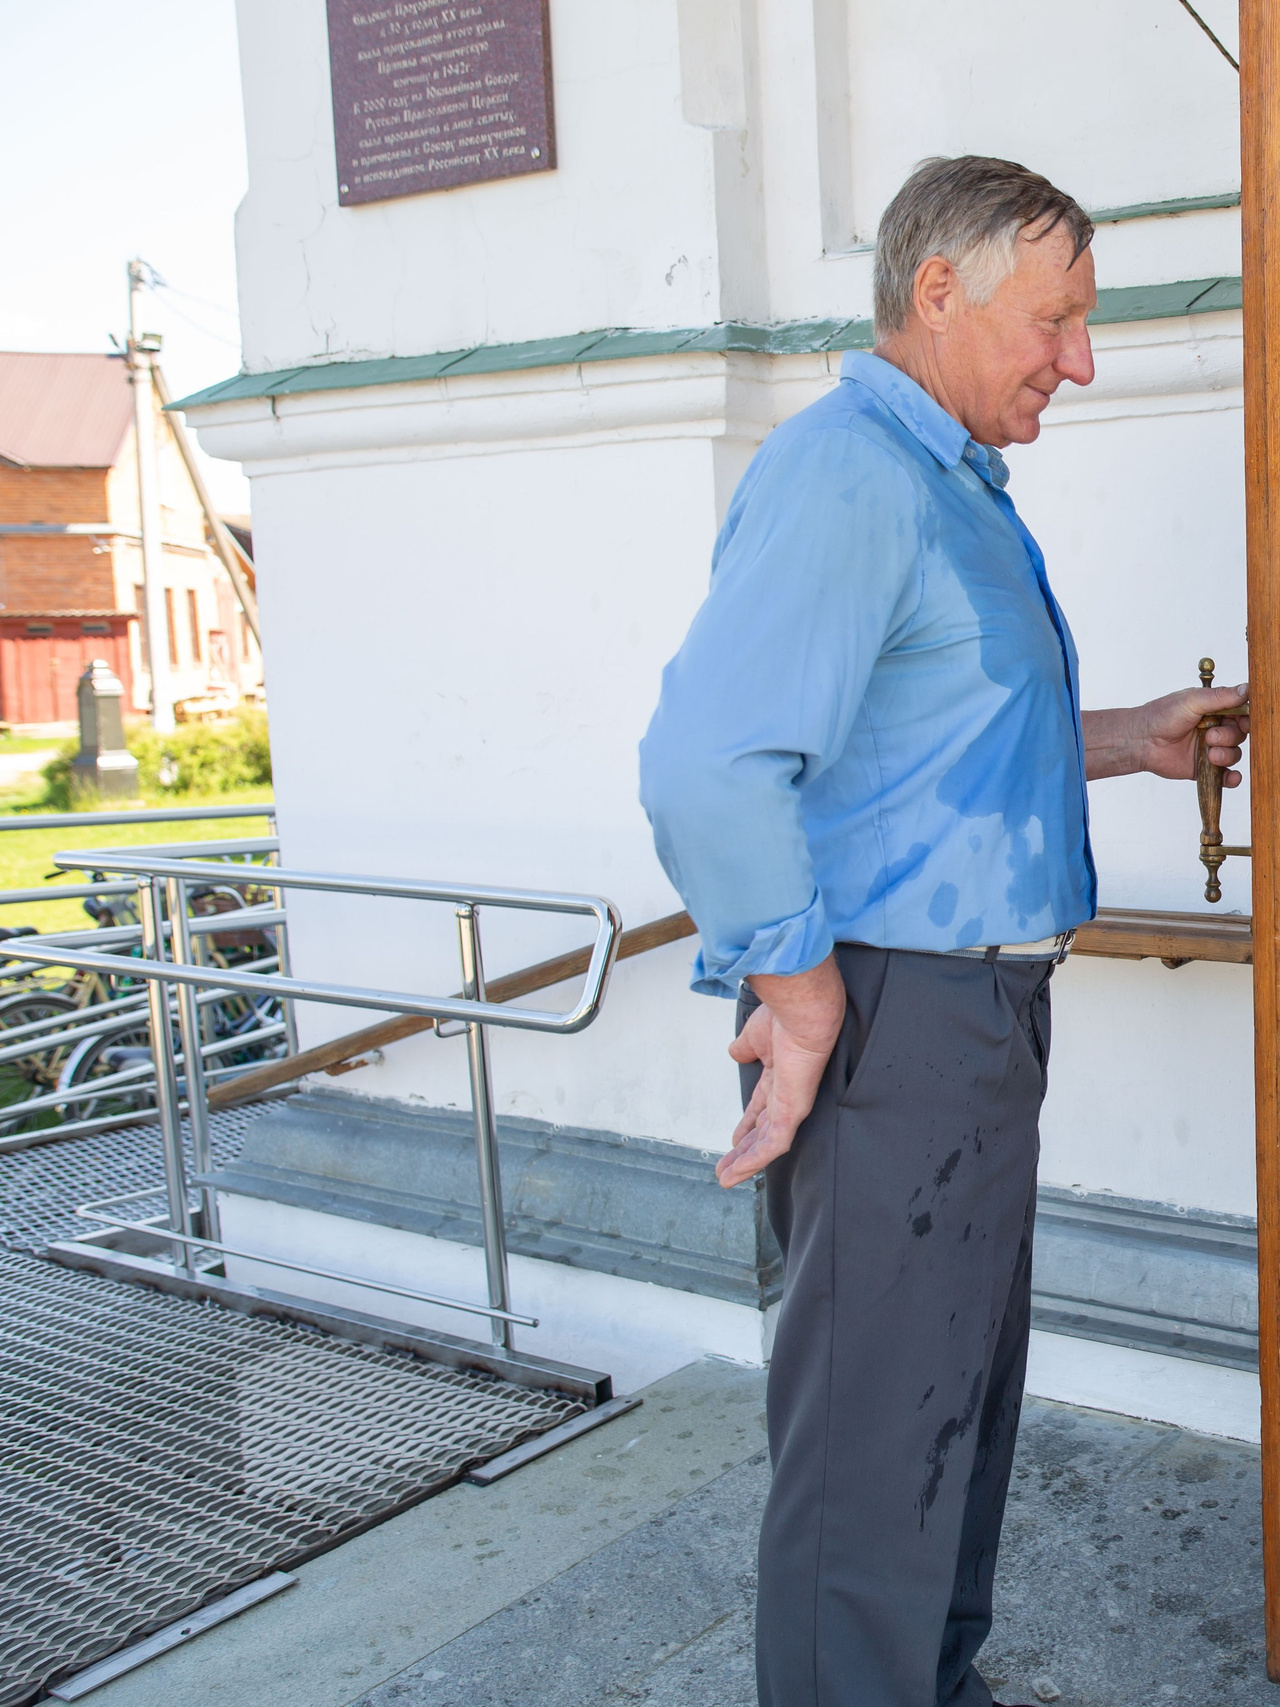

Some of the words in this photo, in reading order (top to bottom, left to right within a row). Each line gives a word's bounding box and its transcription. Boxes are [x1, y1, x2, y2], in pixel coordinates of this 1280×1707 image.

[460, 6, 482, 19] века
[357, 48, 381, 61] была
[446, 25, 473, 40] этого
[364, 97, 386, 113] 2000
[388, 95, 409, 108] году
[425, 80, 482, 99] Юбилейном
[485, 72, 520, 87] Соборе
[365, 111, 400, 134] Русской
[403, 100, 469, 124] Православной
[471, 93, 509, 109] Церкви
[359, 137, 382, 149] была
[384, 124, 441, 146] прославлена
[452, 118, 475, 130] лике
[422, 138, 457, 154] Собору
[428, 152, 481, 172] Российских
[502, 145, 526, 157] века
